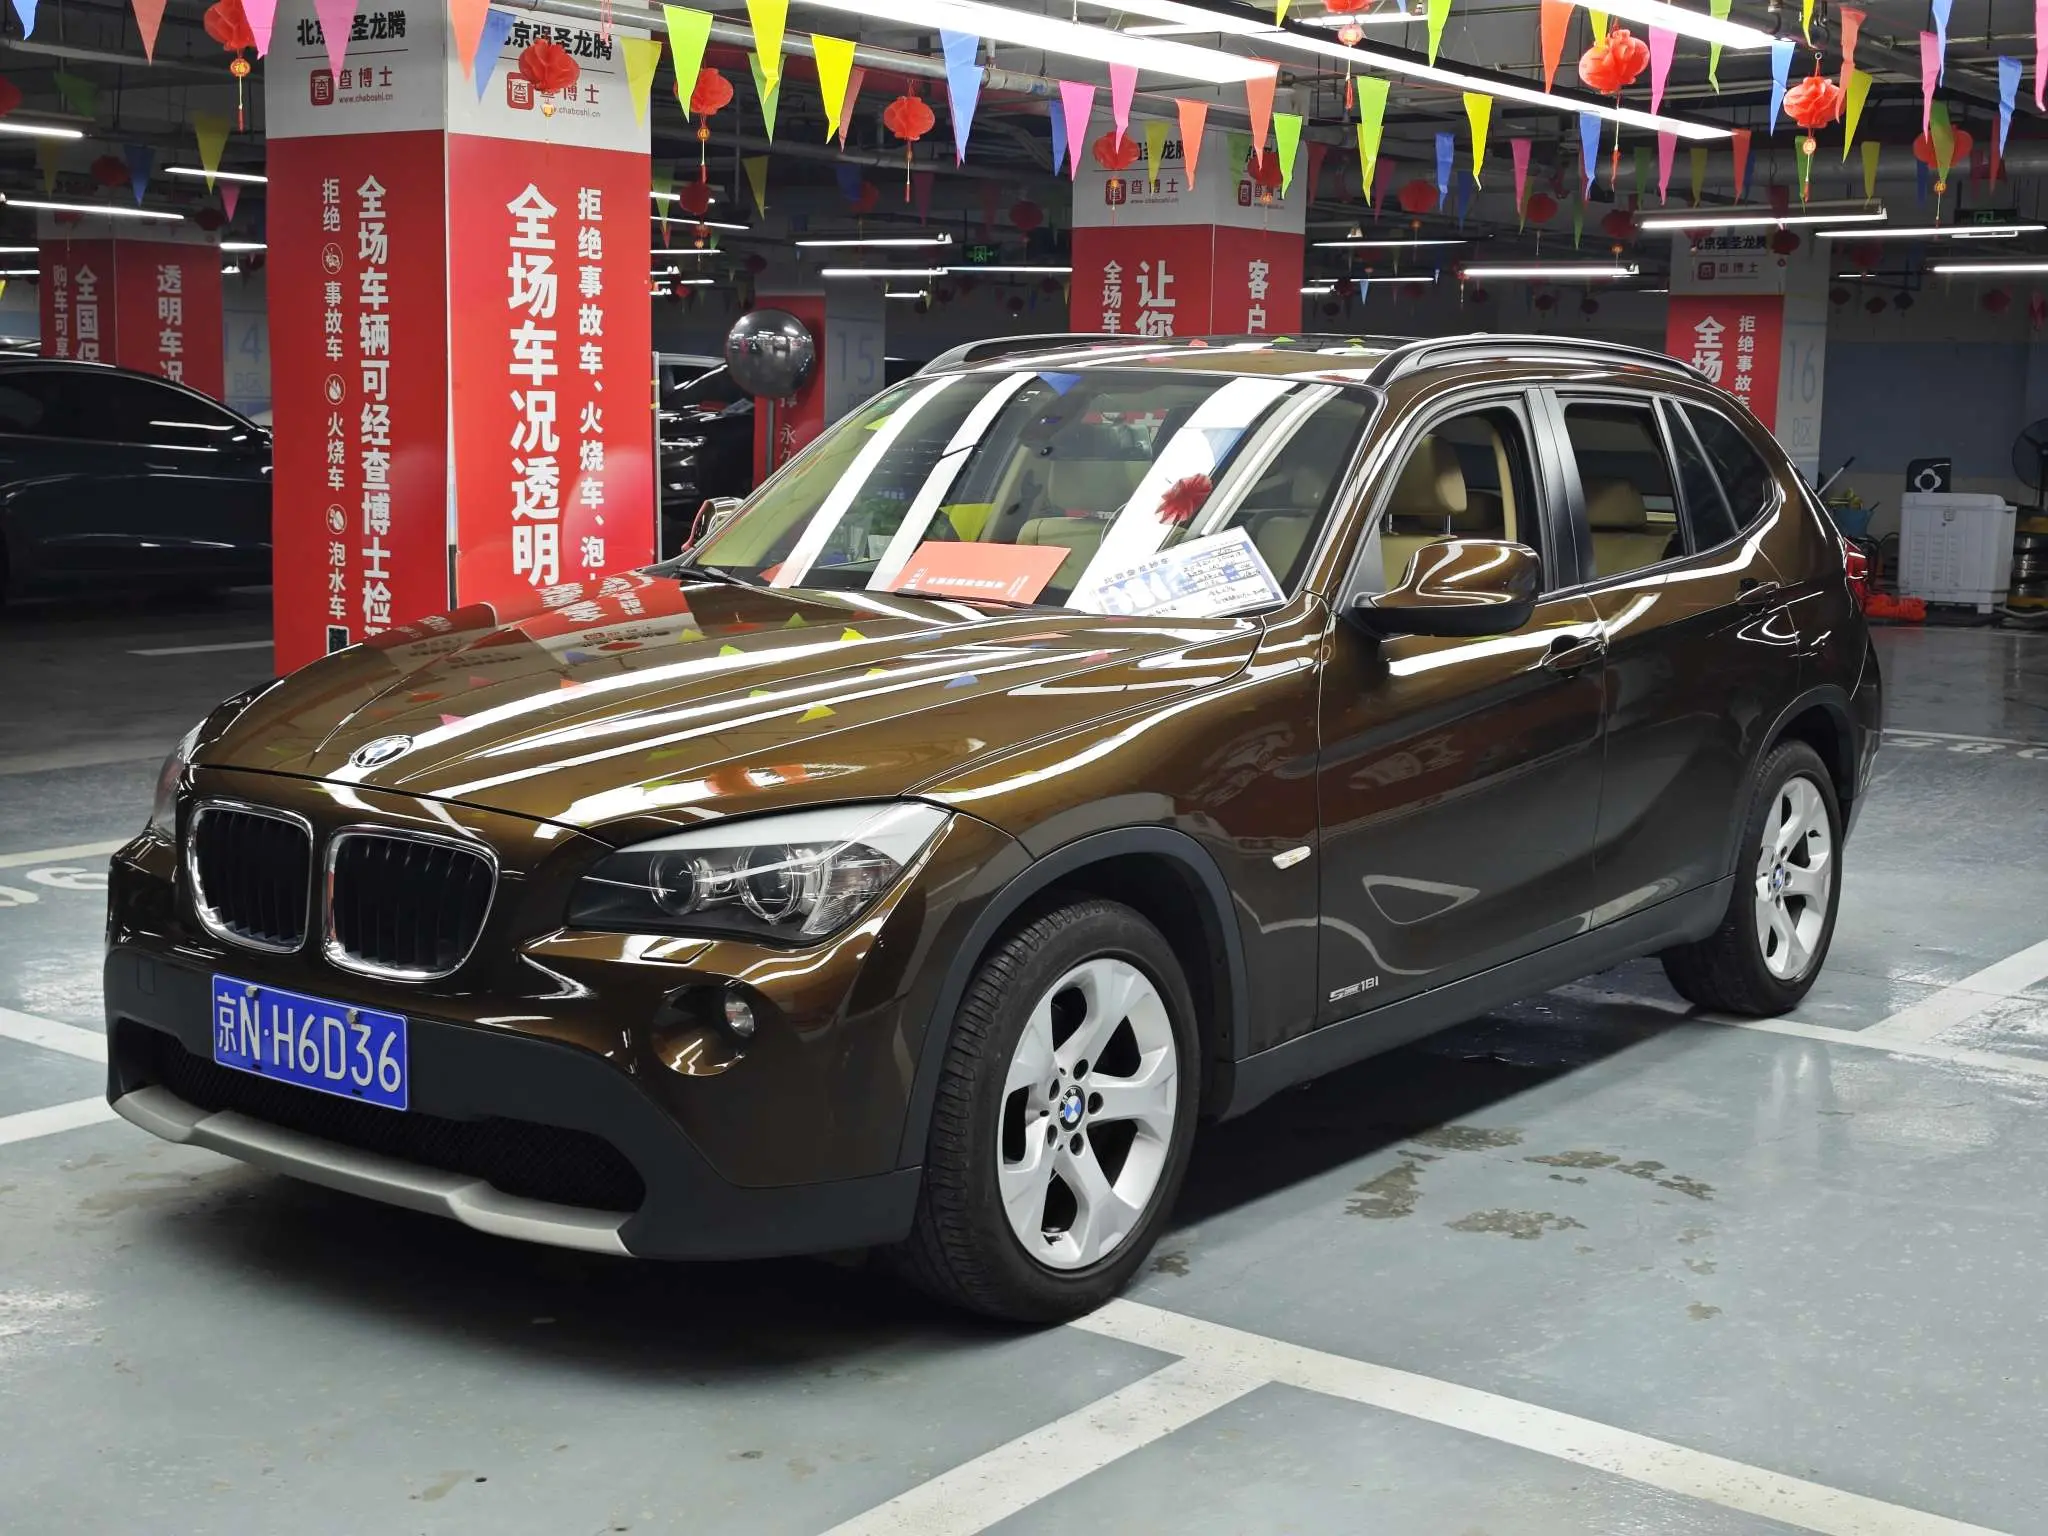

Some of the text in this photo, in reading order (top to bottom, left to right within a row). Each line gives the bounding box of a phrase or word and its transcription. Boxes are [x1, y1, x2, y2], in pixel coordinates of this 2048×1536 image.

[297, 10, 406, 46] 北圣龙腾
[504, 21, 613, 61] 京强圣龙腾
[339, 66, 393, 90] 查博士
[339, 92, 394, 104] www.chaboshi.cn
[540, 104, 601, 118] .chaboshi.cn
[157, 264, 184, 384] 透明车况
[1102, 259, 1123, 334] 全场车
[1248, 259, 1270, 335] 客户
[506, 183, 560, 586] 全场车况透明
[577, 187, 606, 581] 拒绝事故车、火烧车、泡
[836, 330, 876, 386] 15
[1691, 315, 1726, 383] 全场
[1788, 339, 1816, 404] 16
[323, 178, 346, 620] 拒绝 事故车 火烧车 泡水车
[356, 174, 392, 637] 全场车辆可经查博士检
[217, 992, 401, 1093] 京N·H6D36
